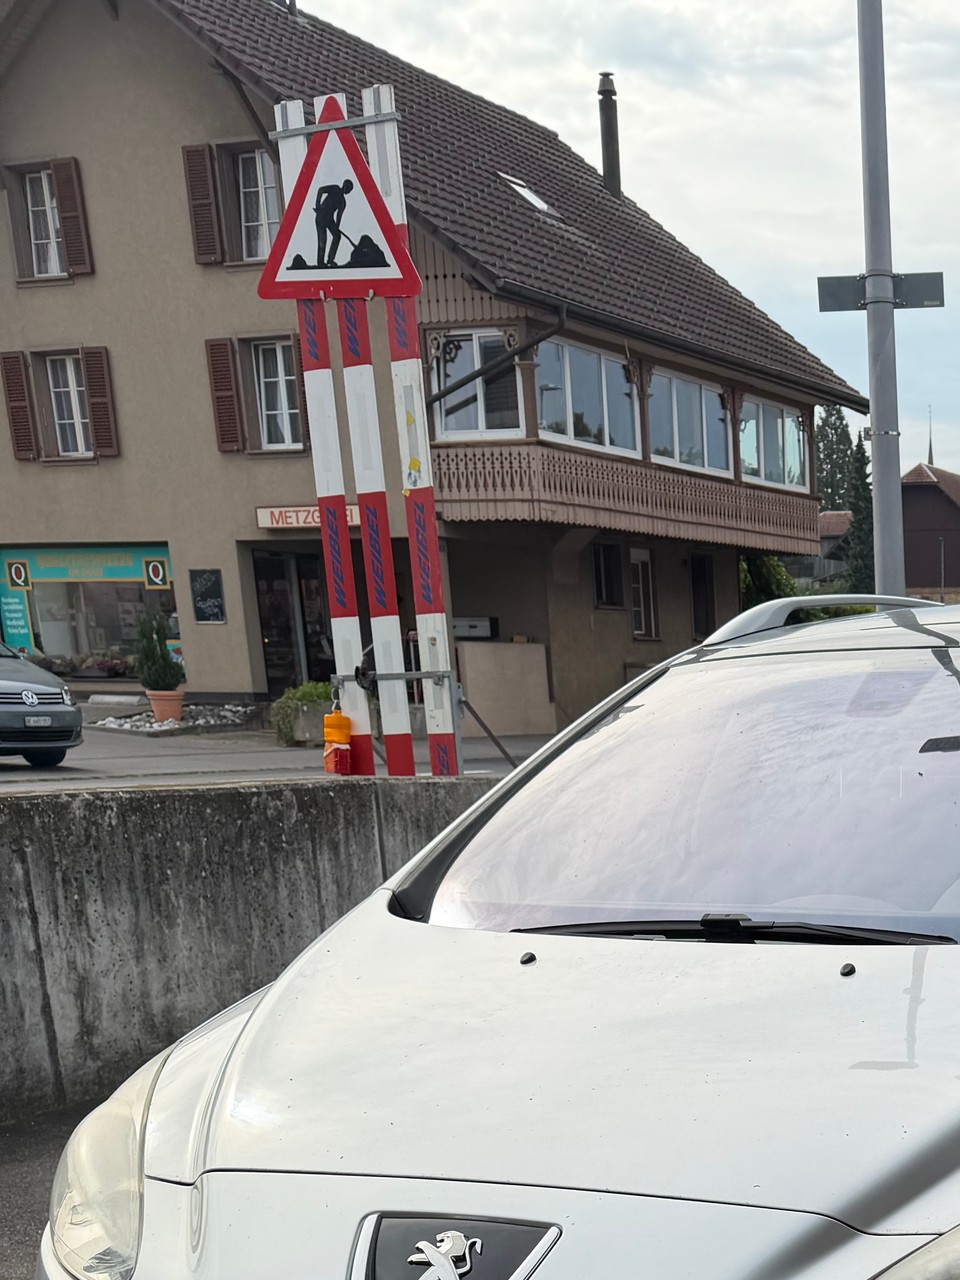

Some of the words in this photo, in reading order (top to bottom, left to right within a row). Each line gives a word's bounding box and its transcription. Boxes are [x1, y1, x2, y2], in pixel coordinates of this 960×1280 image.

[270, 508, 354, 526] METZGI
[11, 563, 26, 586] Q
[148, 561, 163, 585] Q
[325, 506, 347, 609] WEIBEL
[365, 504, 387, 609] WEIBEL
[414, 501, 433, 605] WEIBEL
